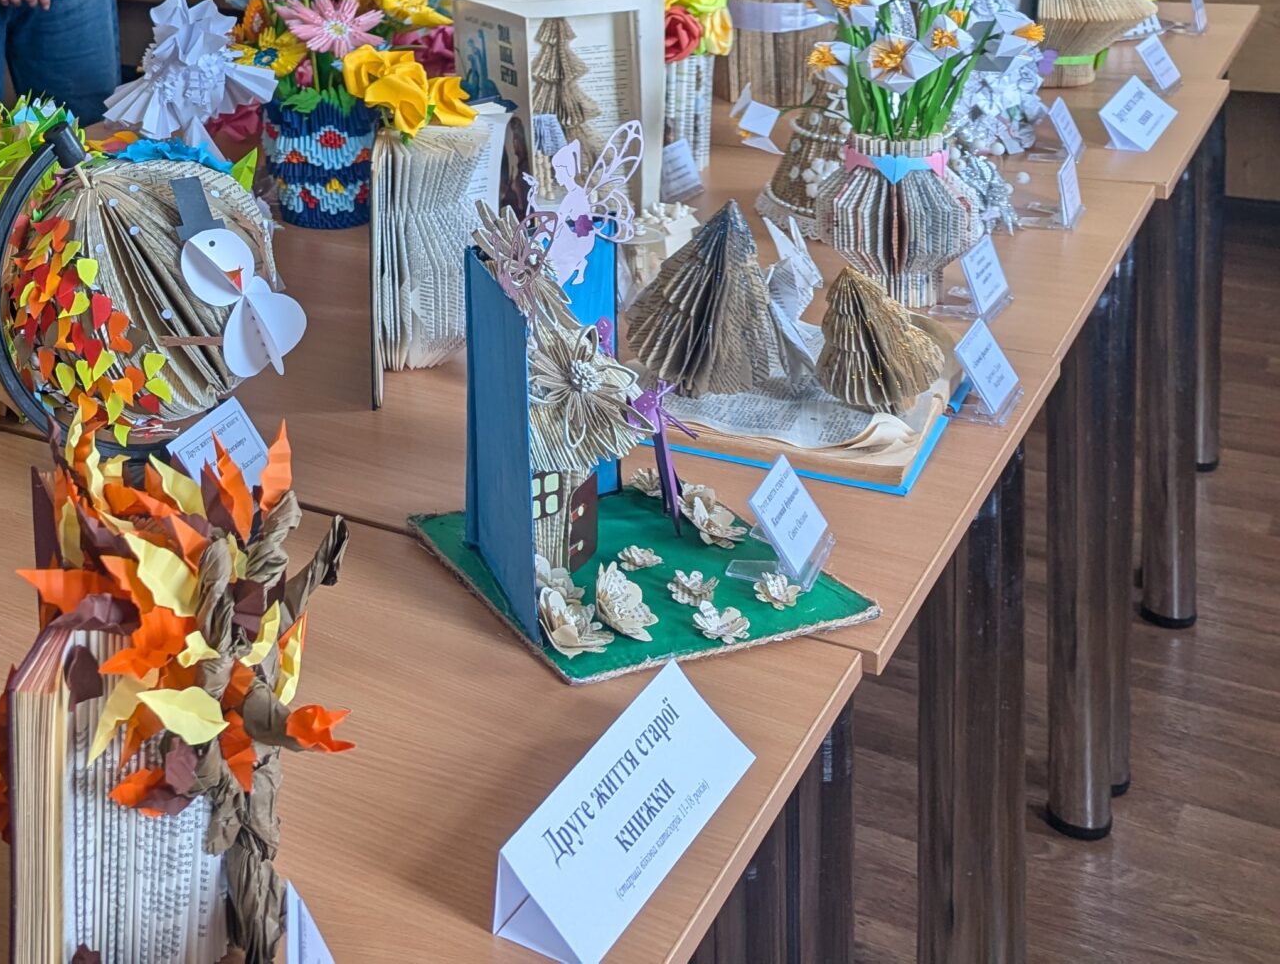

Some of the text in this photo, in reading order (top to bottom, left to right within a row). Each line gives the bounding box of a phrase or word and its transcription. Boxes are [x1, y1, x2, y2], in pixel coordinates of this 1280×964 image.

[541, 696, 680, 870] Друге життя старої
[614, 778, 676, 854] книжки
[678, 794, 696, 818] 11-18
